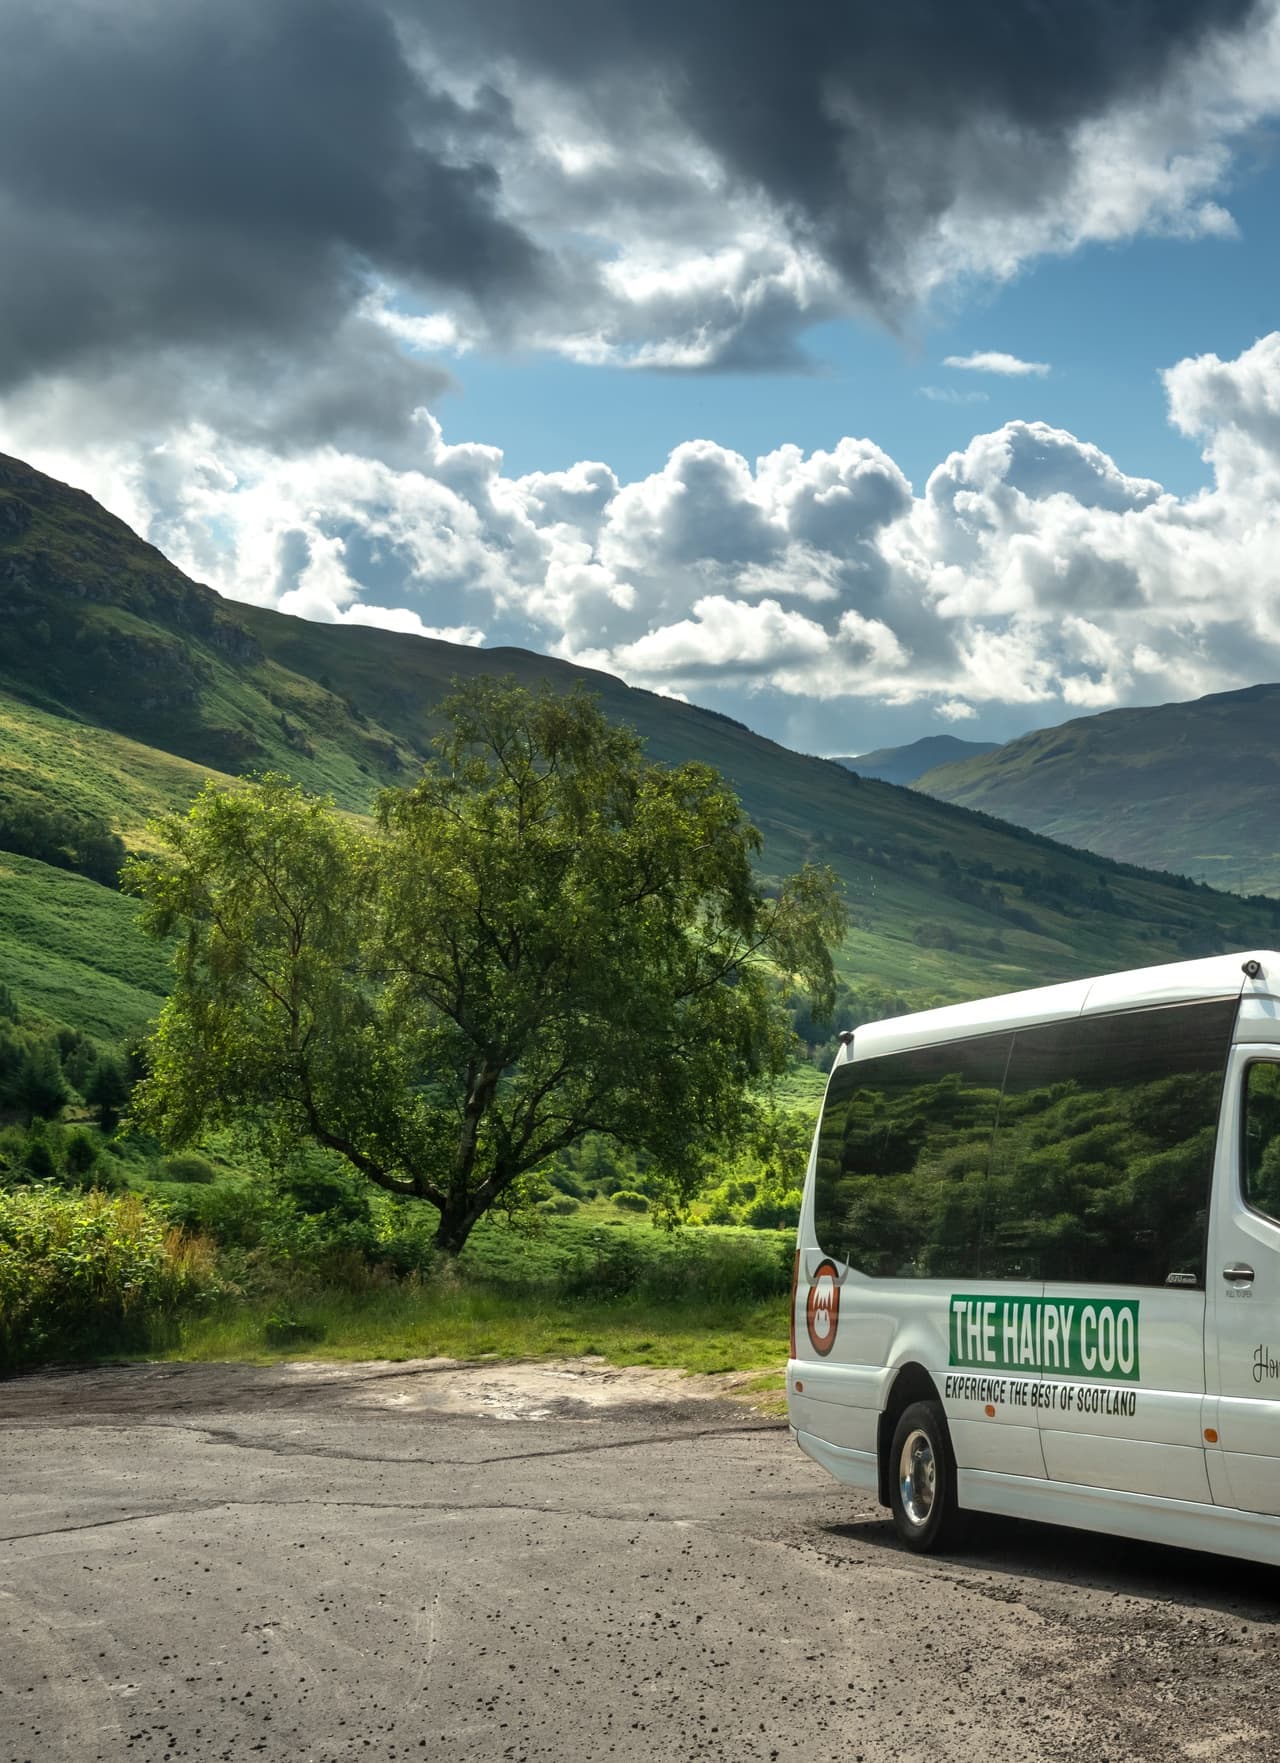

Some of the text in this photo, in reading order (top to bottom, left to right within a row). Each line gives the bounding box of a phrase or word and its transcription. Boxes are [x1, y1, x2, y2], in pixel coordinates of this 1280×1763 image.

[953, 1301, 1134, 1374] THE HAIRY COO
[945, 1376, 1137, 1417] EXPERIENCE THE BEST OF SCOTLAND
